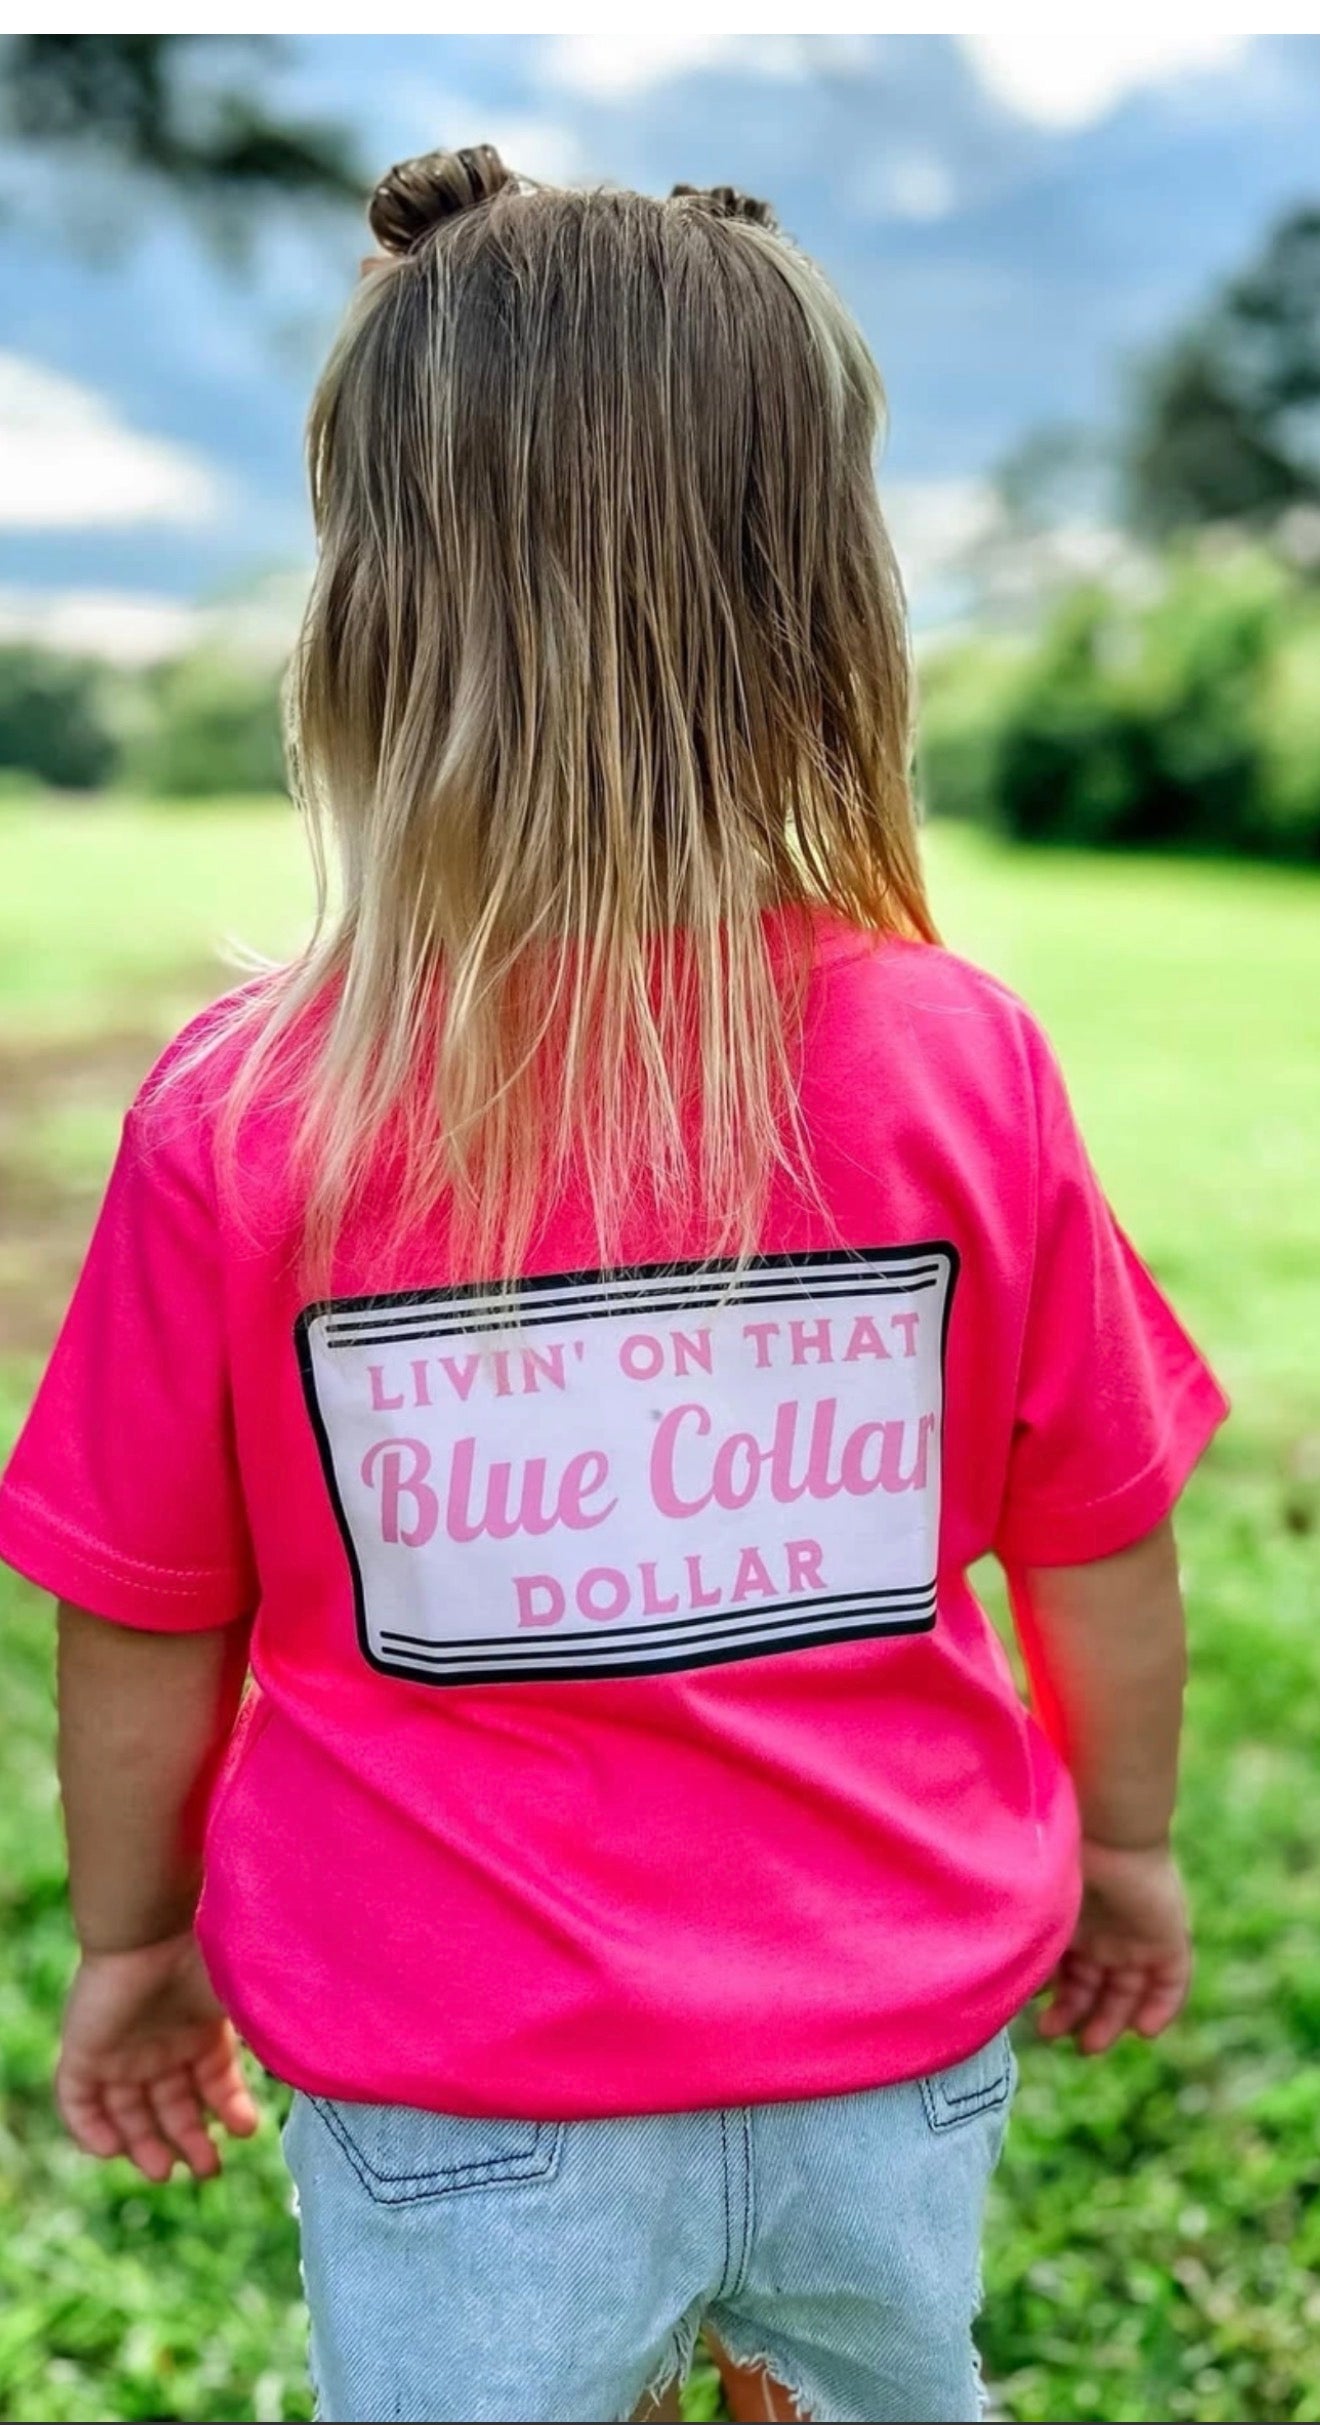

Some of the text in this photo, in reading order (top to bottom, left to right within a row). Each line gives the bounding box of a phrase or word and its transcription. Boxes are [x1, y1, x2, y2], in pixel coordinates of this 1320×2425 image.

[367, 1312, 921, 1411] LIVIN' ON THAT
[361, 1397, 935, 1548] Blue Collar
[513, 1538, 828, 1628] DOLLAR
